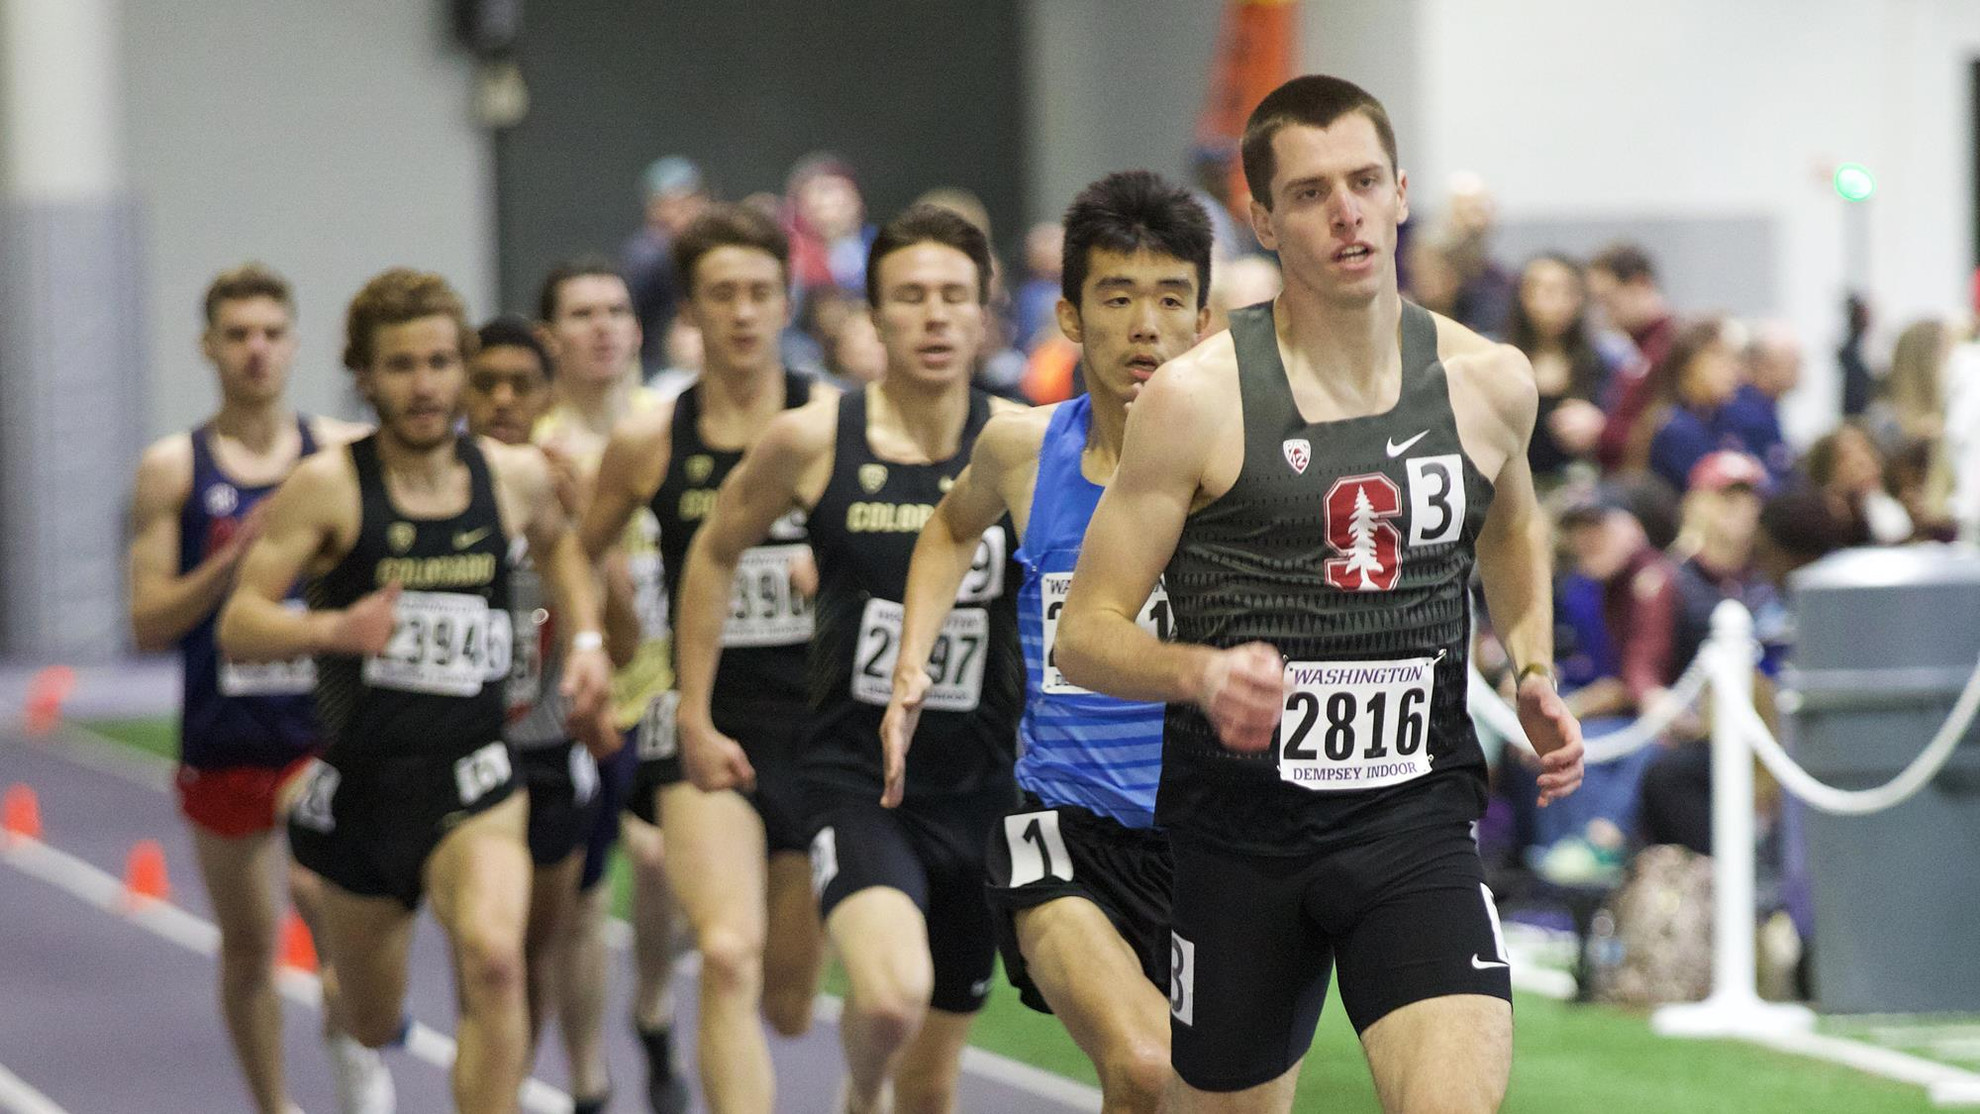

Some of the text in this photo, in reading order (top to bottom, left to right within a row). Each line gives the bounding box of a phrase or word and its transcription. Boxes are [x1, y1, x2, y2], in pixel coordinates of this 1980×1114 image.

[846, 501, 935, 532] COLOR
[1420, 462, 1453, 540] 3
[864, 626, 979, 686] 297
[1295, 665, 1423, 685] WASHINGTON
[1283, 687, 1425, 761] 2816
[1293, 761, 1417, 781] DEMPSEY INDOOR
[1022, 818, 1052, 878] 1
